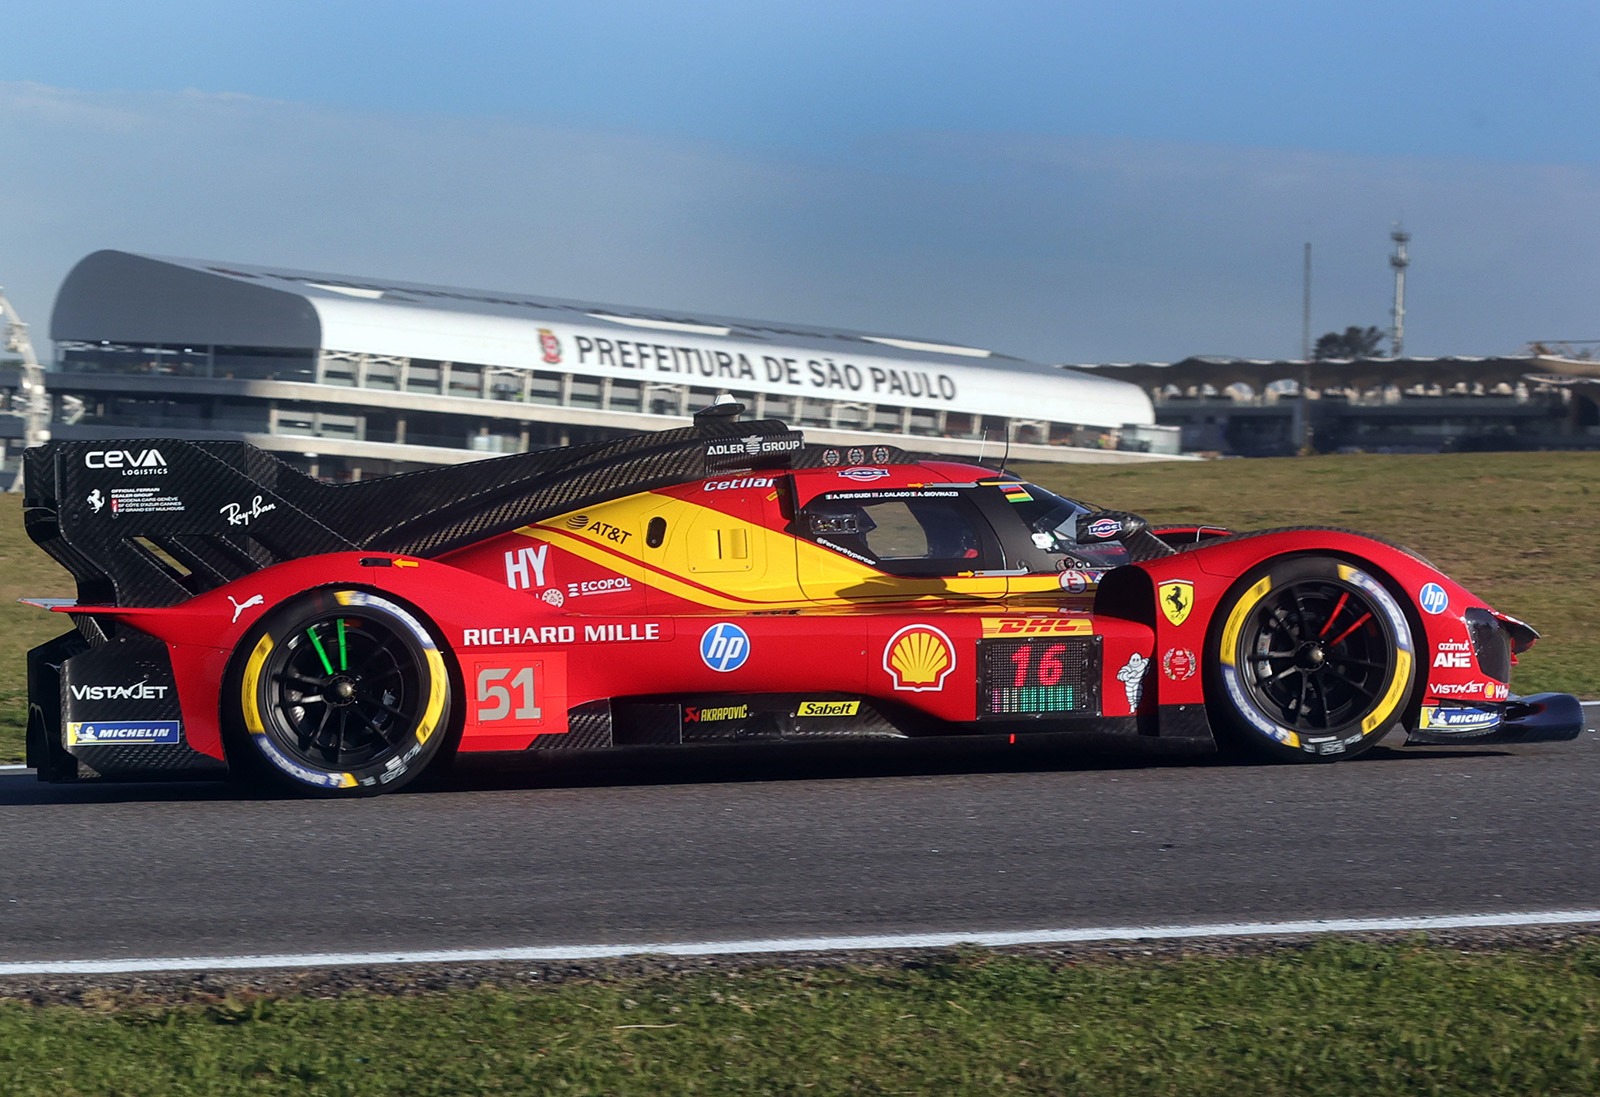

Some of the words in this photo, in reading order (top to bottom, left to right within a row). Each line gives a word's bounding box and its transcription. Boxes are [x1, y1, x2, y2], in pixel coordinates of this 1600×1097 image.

[575, 335, 755, 380] PREFEITURA
[762, 356, 802, 385] DE
[808, 358, 862, 391] SÃO
[869, 367, 956, 400] PAULO
[706, 444, 745, 456] ADLER
[762, 440, 800, 452] GROUP
[122, 468, 168, 476] LOGISTICS
[220, 495, 276, 525] Ray-Ban
[588, 521, 632, 544] AT&T
[504, 545, 548, 590] HY
[581, 577, 631, 592] ECOPOL
[1424, 585, 1443, 613] hp
[463, 626, 575, 646] RICHARD
[584, 623, 660, 642] MILLE
[998, 618, 1079, 633] DHL
[706, 624, 745, 670] hp
[1438, 638, 1470, 651] azimut
[1011, 643, 1066, 687] 16
[1433, 652, 1472, 668] AHE
[477, 667, 541, 721] 51
[804, 703, 853, 715] Sabelt
[98, 728, 170, 738] MICHELIN
